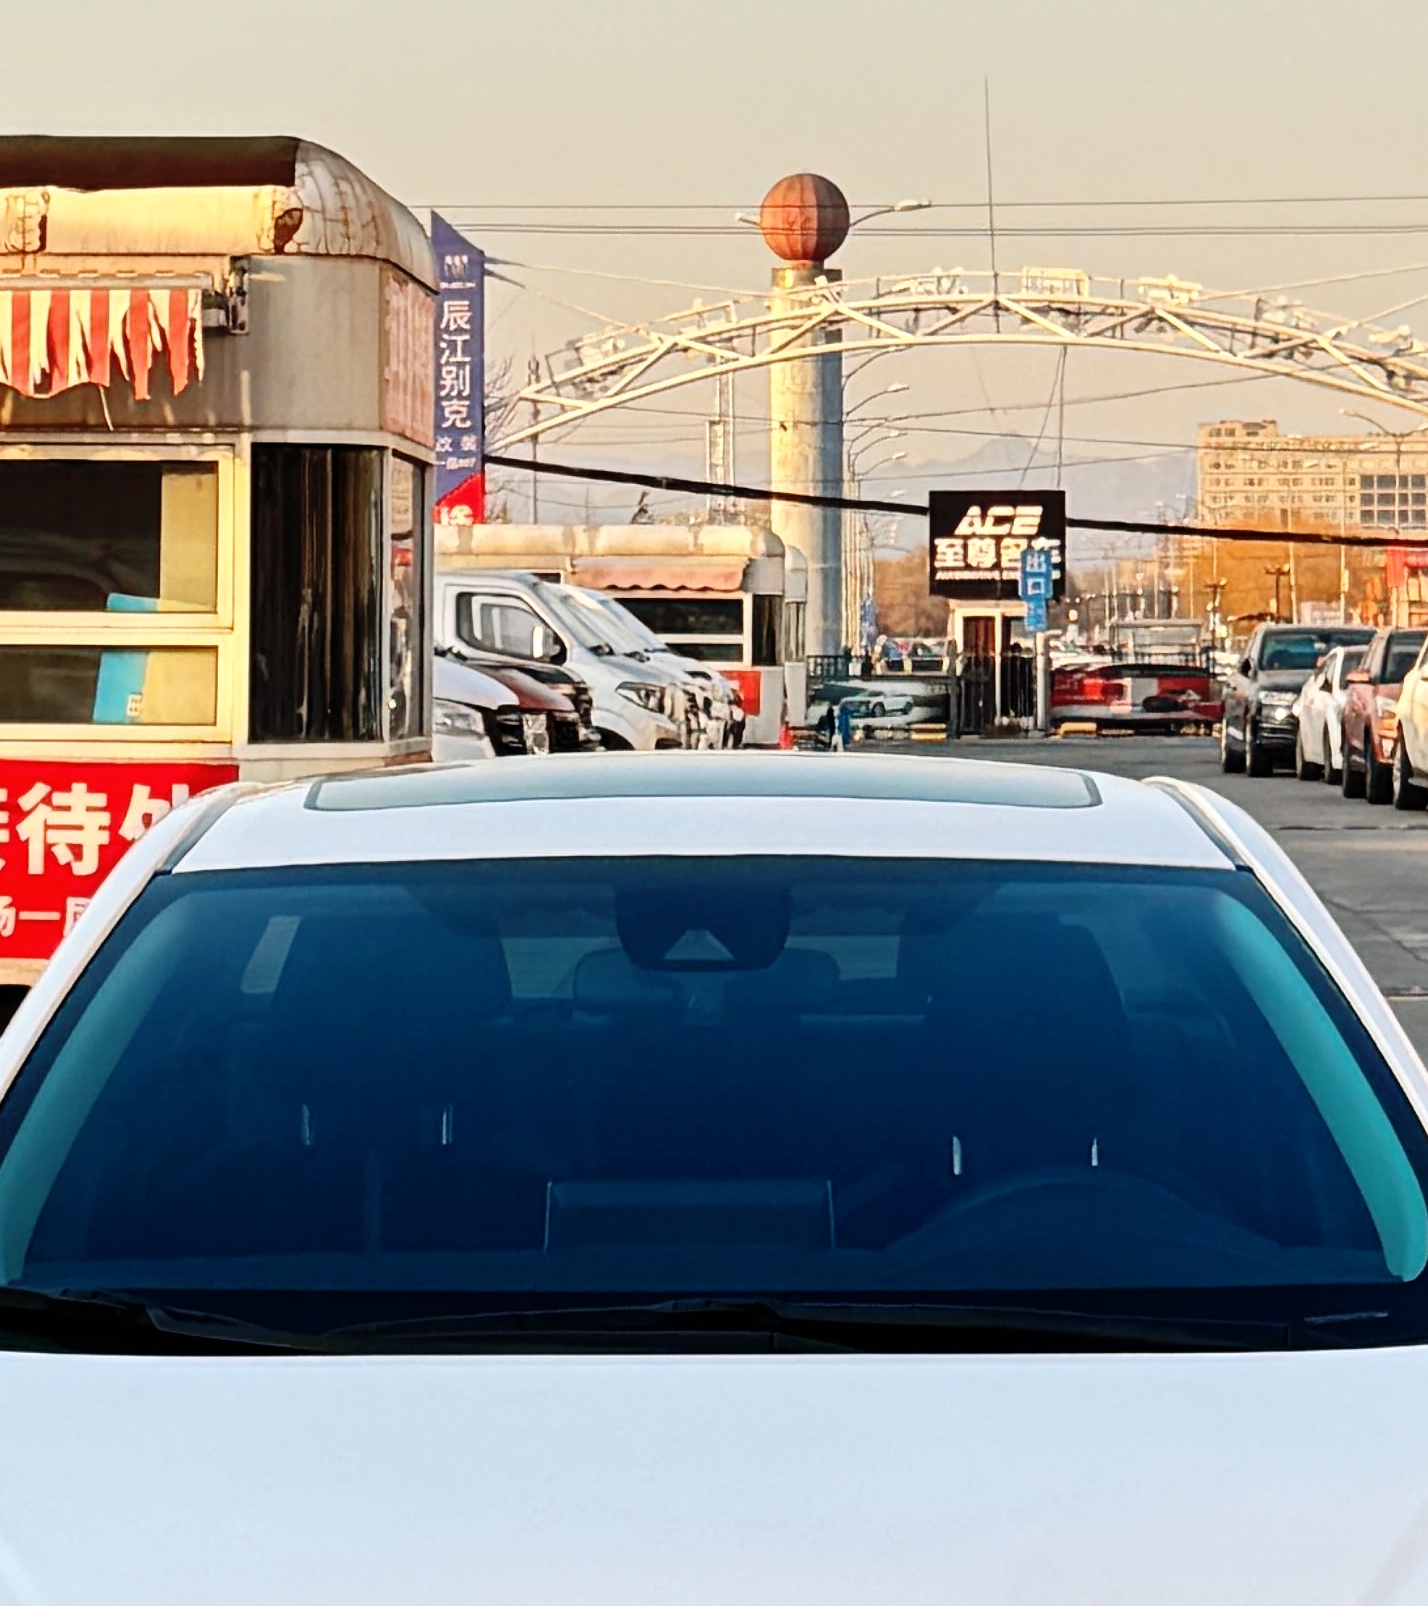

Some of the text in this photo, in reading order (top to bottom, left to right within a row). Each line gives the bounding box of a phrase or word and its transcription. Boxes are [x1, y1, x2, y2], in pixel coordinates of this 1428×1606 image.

[439, 300, 472, 428] 辰江别克
[954, 505, 1043, 535] ACE
[1026, 553, 1047, 595] 出口
